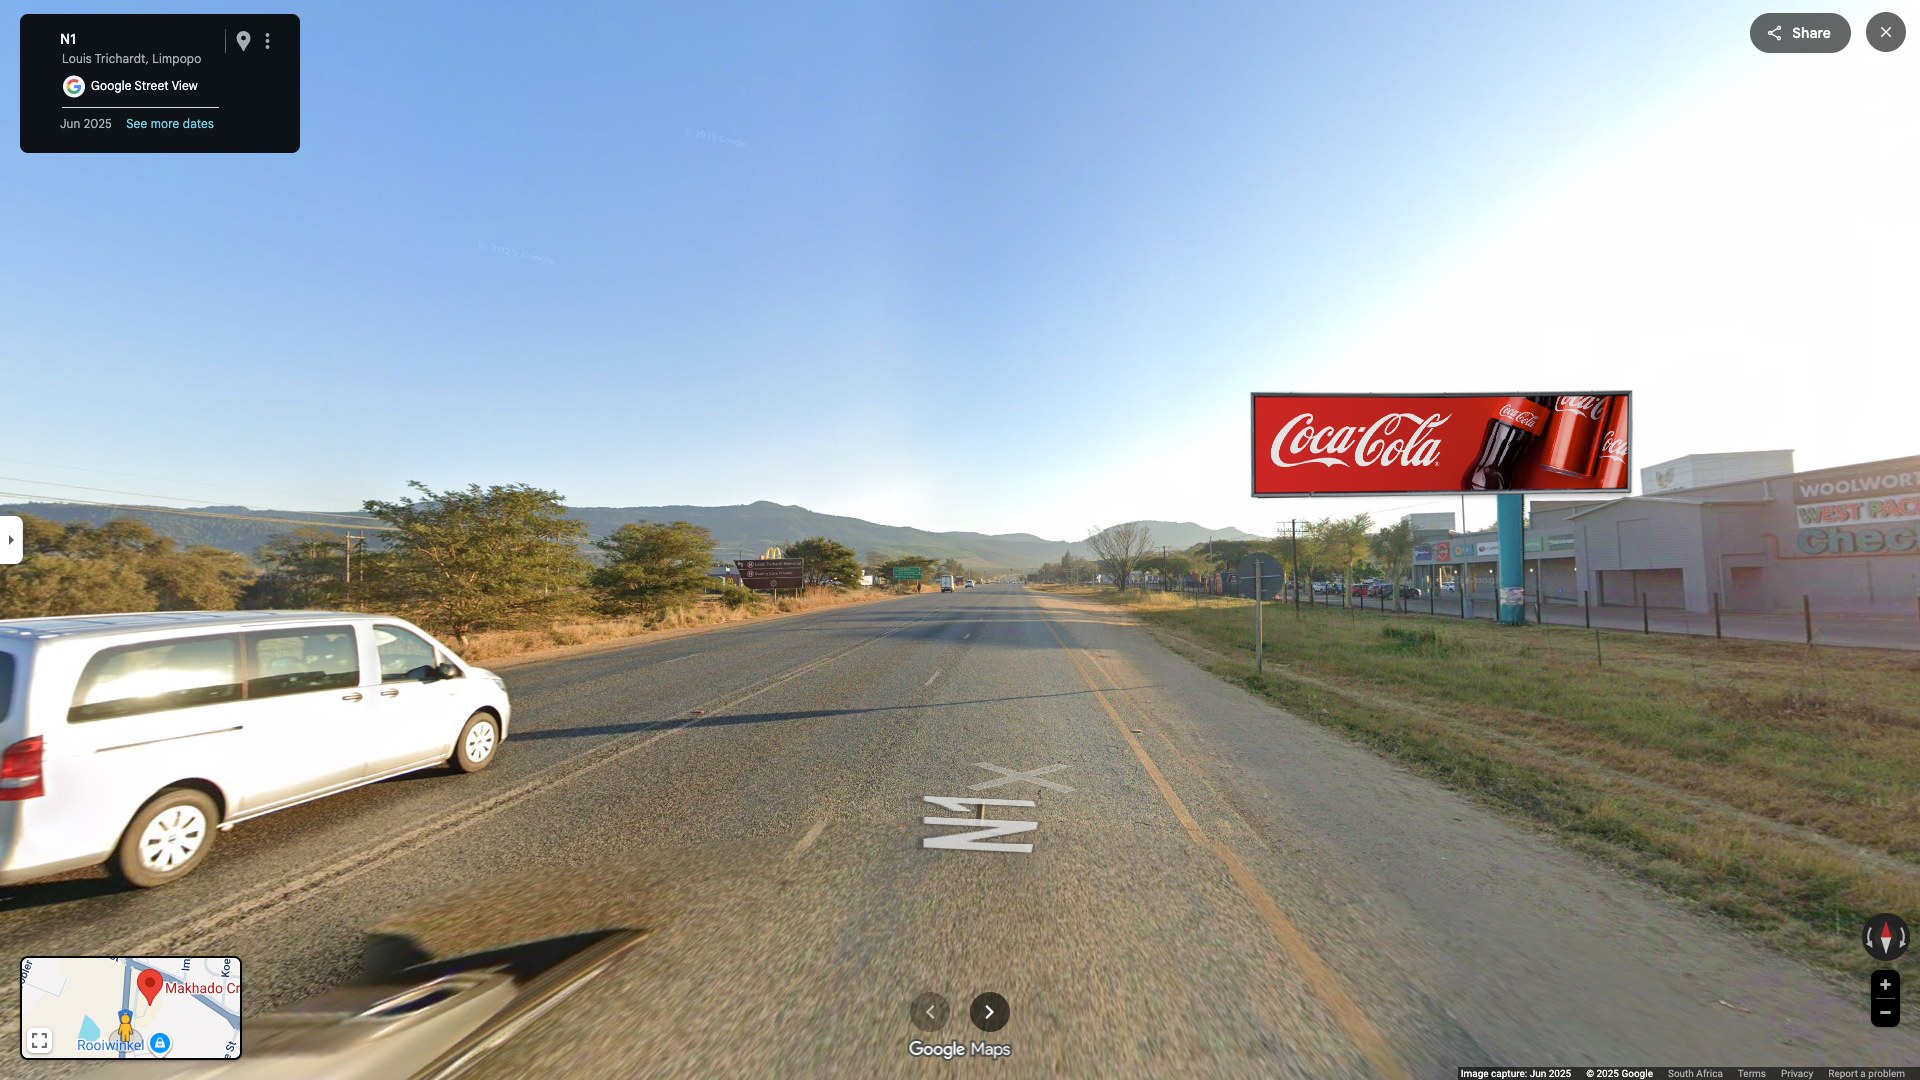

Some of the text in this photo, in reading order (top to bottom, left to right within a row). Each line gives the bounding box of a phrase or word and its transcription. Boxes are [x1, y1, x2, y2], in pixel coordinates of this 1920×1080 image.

[1499, 404, 1538, 429] Coca-Cola
[1269, 412, 1453, 467] Coca-Cola
[1800, 502, 1864, 524] WEST
[1797, 522, 1920, 555] Chec
